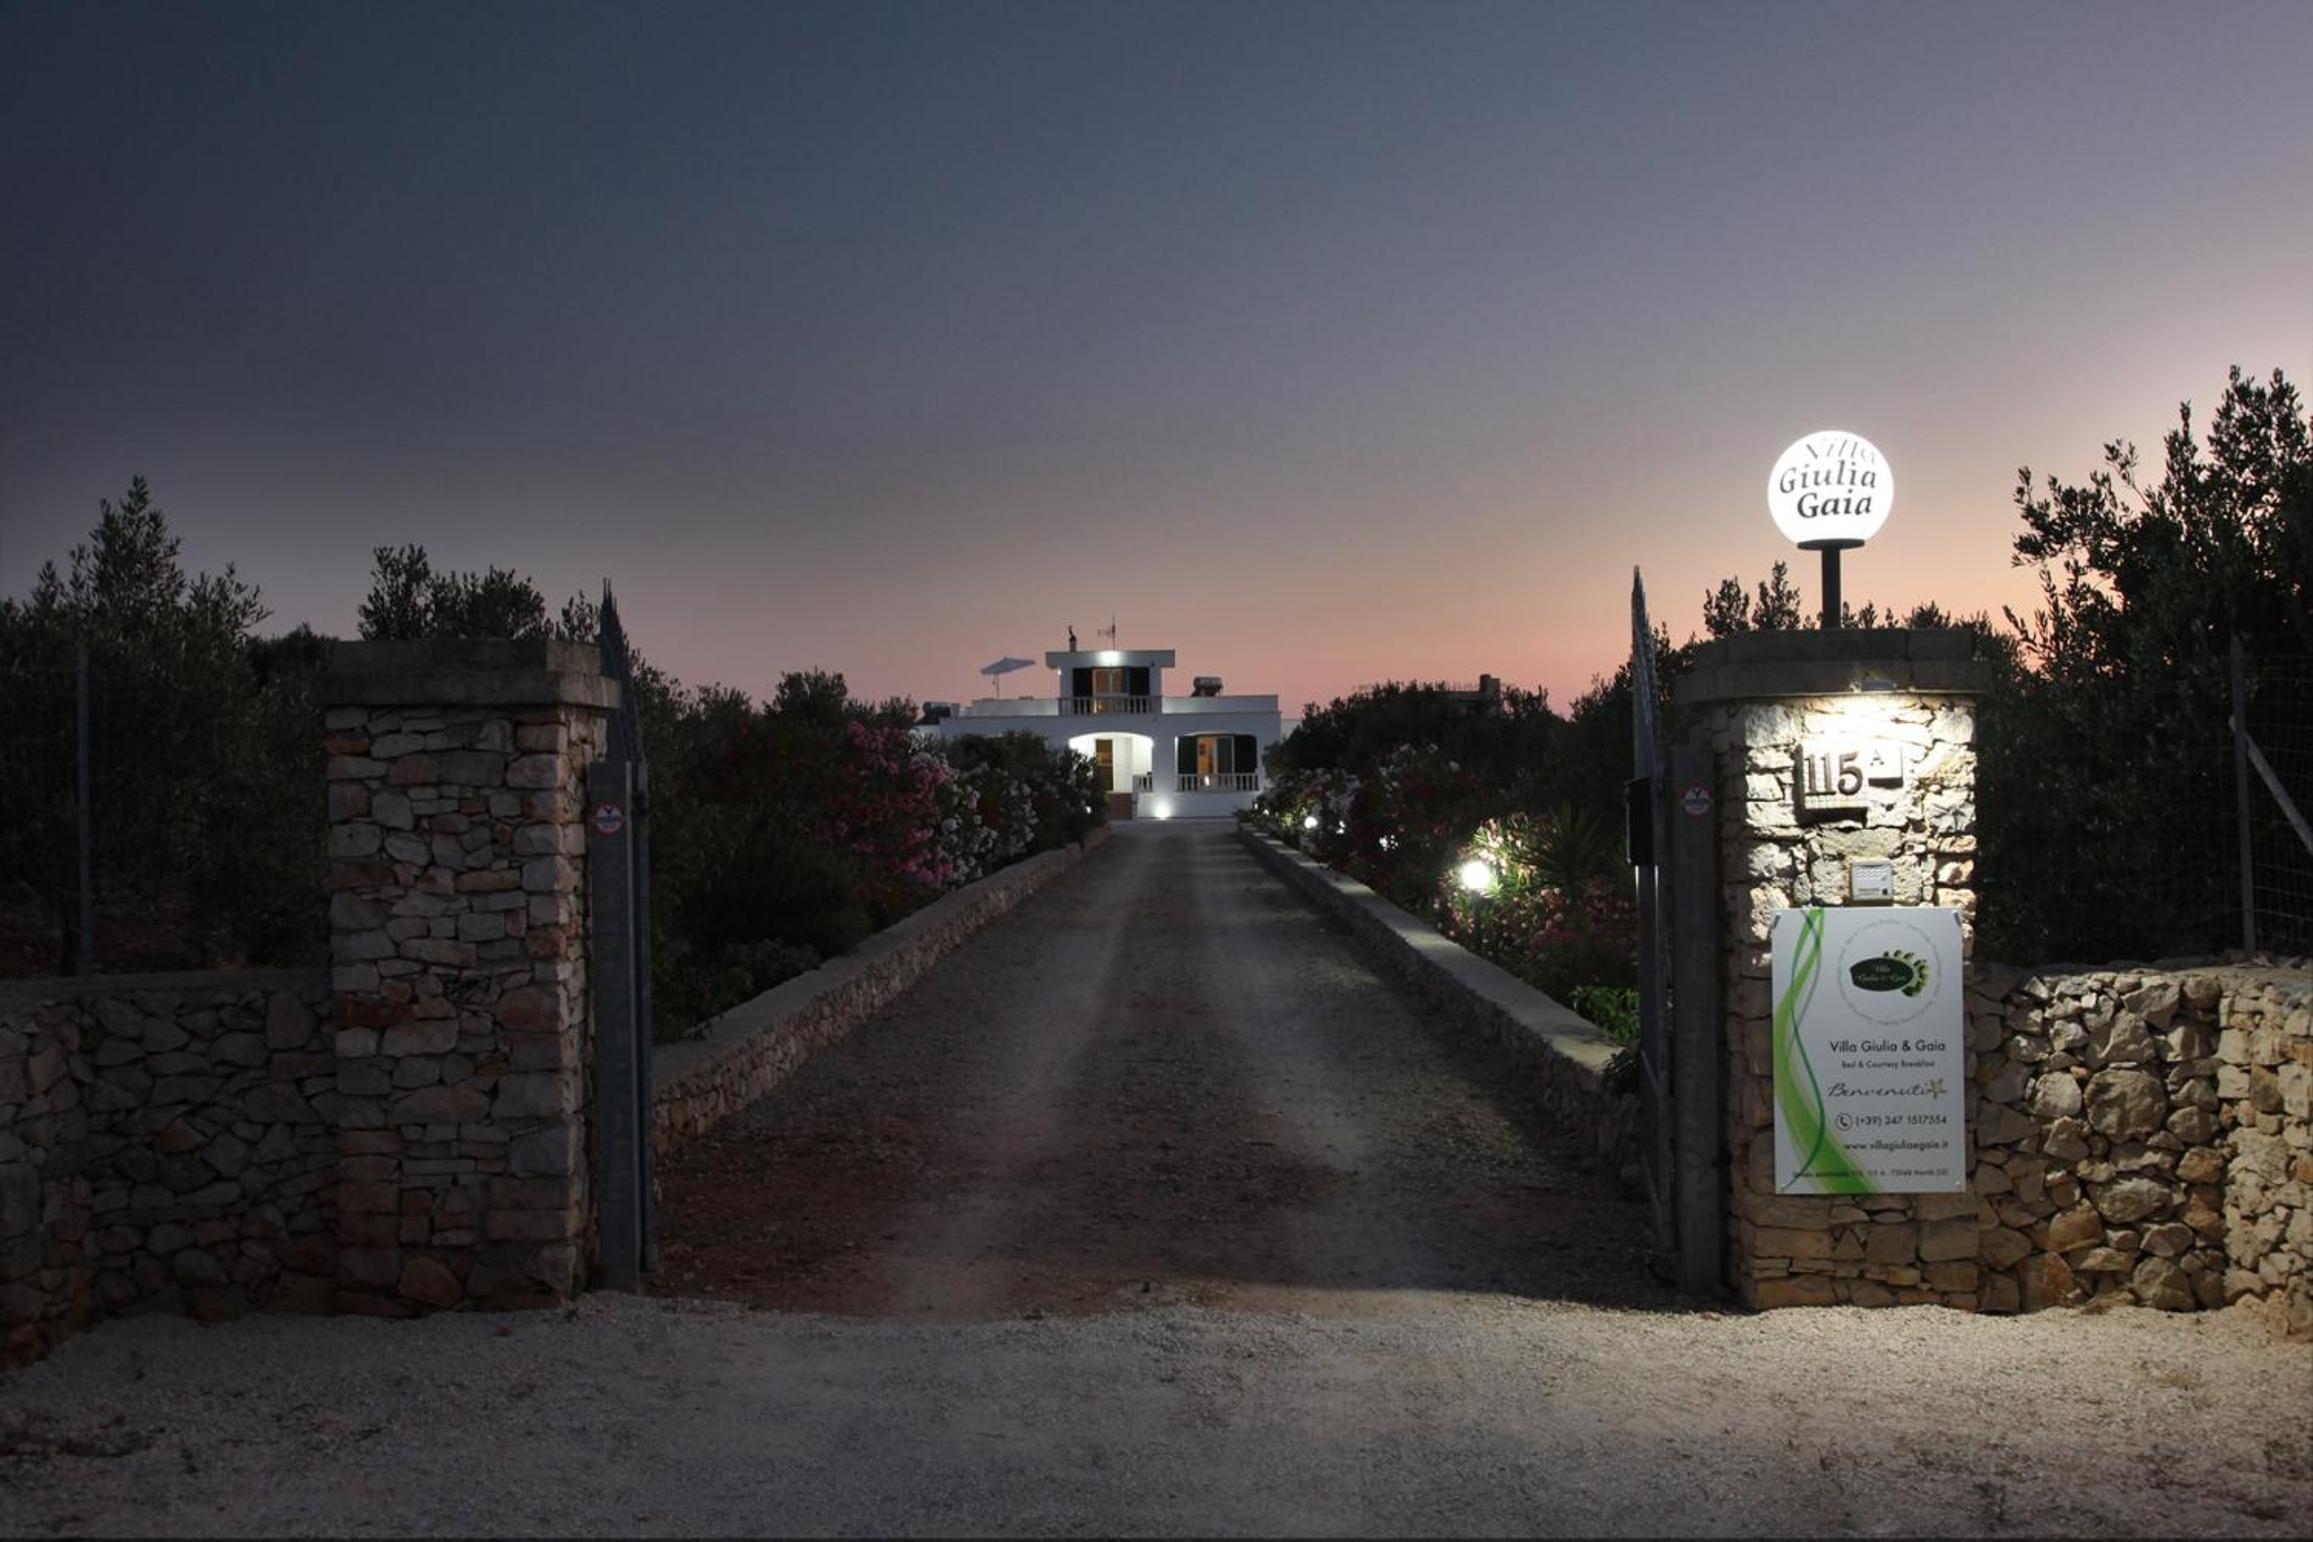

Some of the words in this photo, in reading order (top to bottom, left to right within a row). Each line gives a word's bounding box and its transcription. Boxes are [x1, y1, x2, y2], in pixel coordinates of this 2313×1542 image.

[1779, 460, 1876, 494] Giulia
[1797, 489, 1872, 519] Gaia
[1804, 751, 1863, 796] 115
[1830, 1040, 1857, 1053] Villa
[1861, 1039, 1898, 1053] Giulia
[1902, 1040, 1911, 1052] &
[1915, 1039, 1947, 1052] Gaia
[1842, 1060, 1856, 1068] Bed
[1827, 1081, 1929, 1099] Benvenuti
[1855, 1114, 1882, 1127] (+39)
[1884, 1114, 1903, 1125] 347
